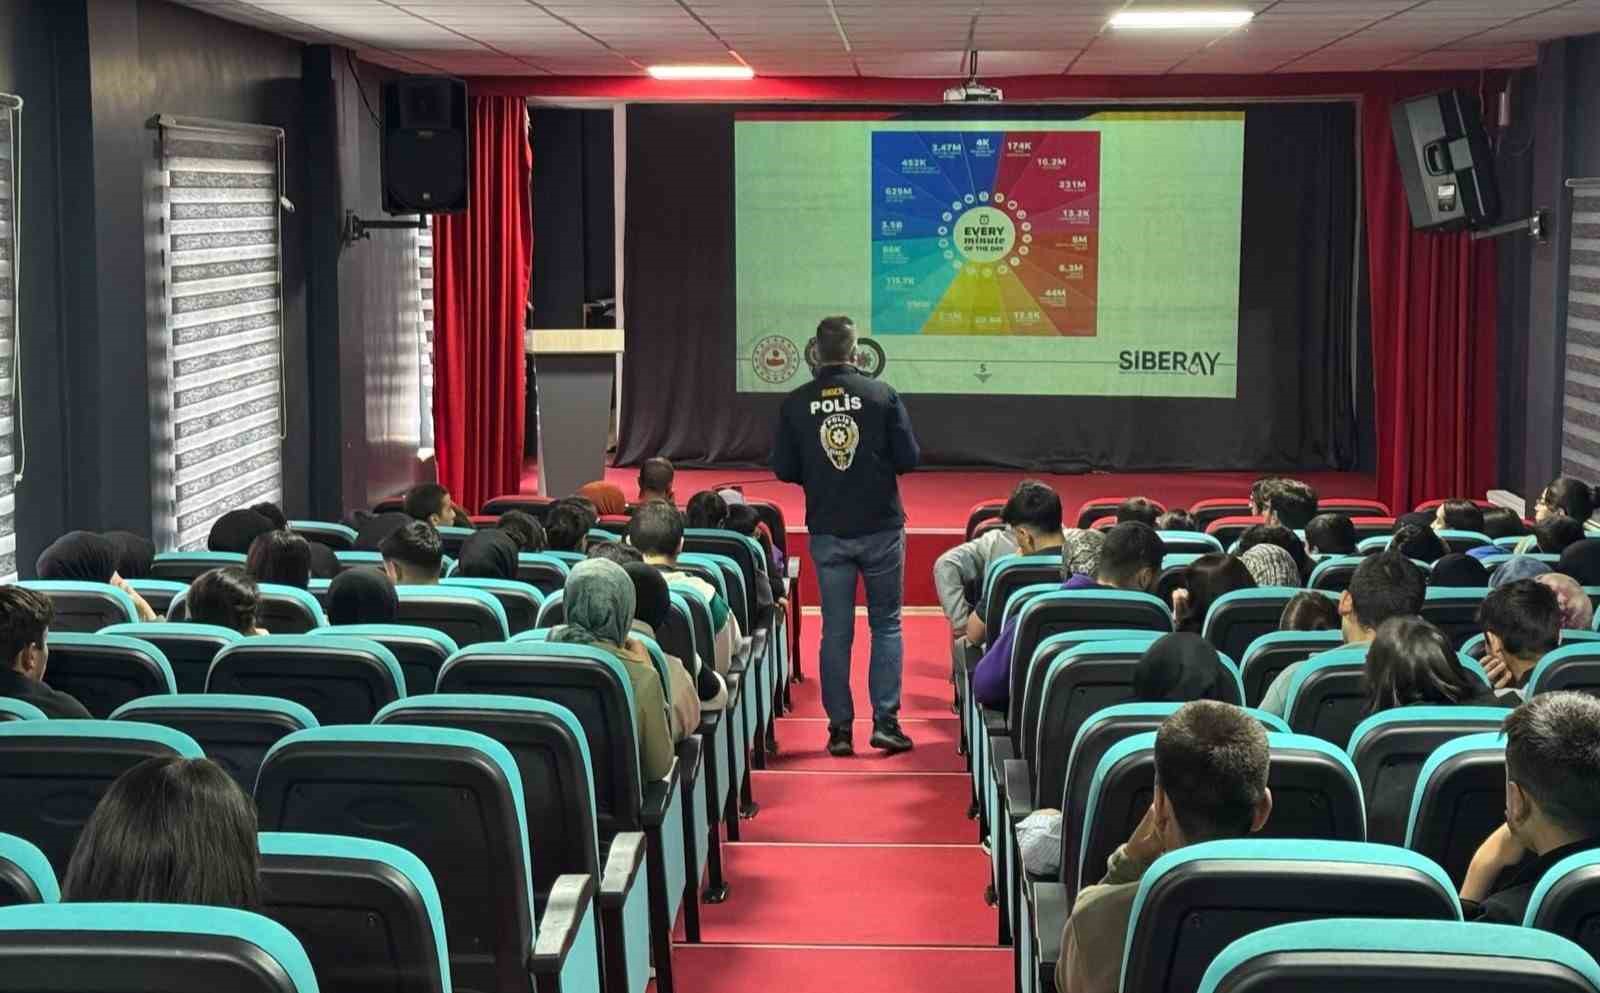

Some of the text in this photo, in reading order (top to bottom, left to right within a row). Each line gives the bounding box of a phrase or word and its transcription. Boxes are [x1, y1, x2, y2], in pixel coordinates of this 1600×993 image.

[1007, 142, 1032, 150] 174K
[964, 227, 1005, 236] EVERY
[964, 236, 1006, 245] minute
[810, 393, 862, 415] POLİS
